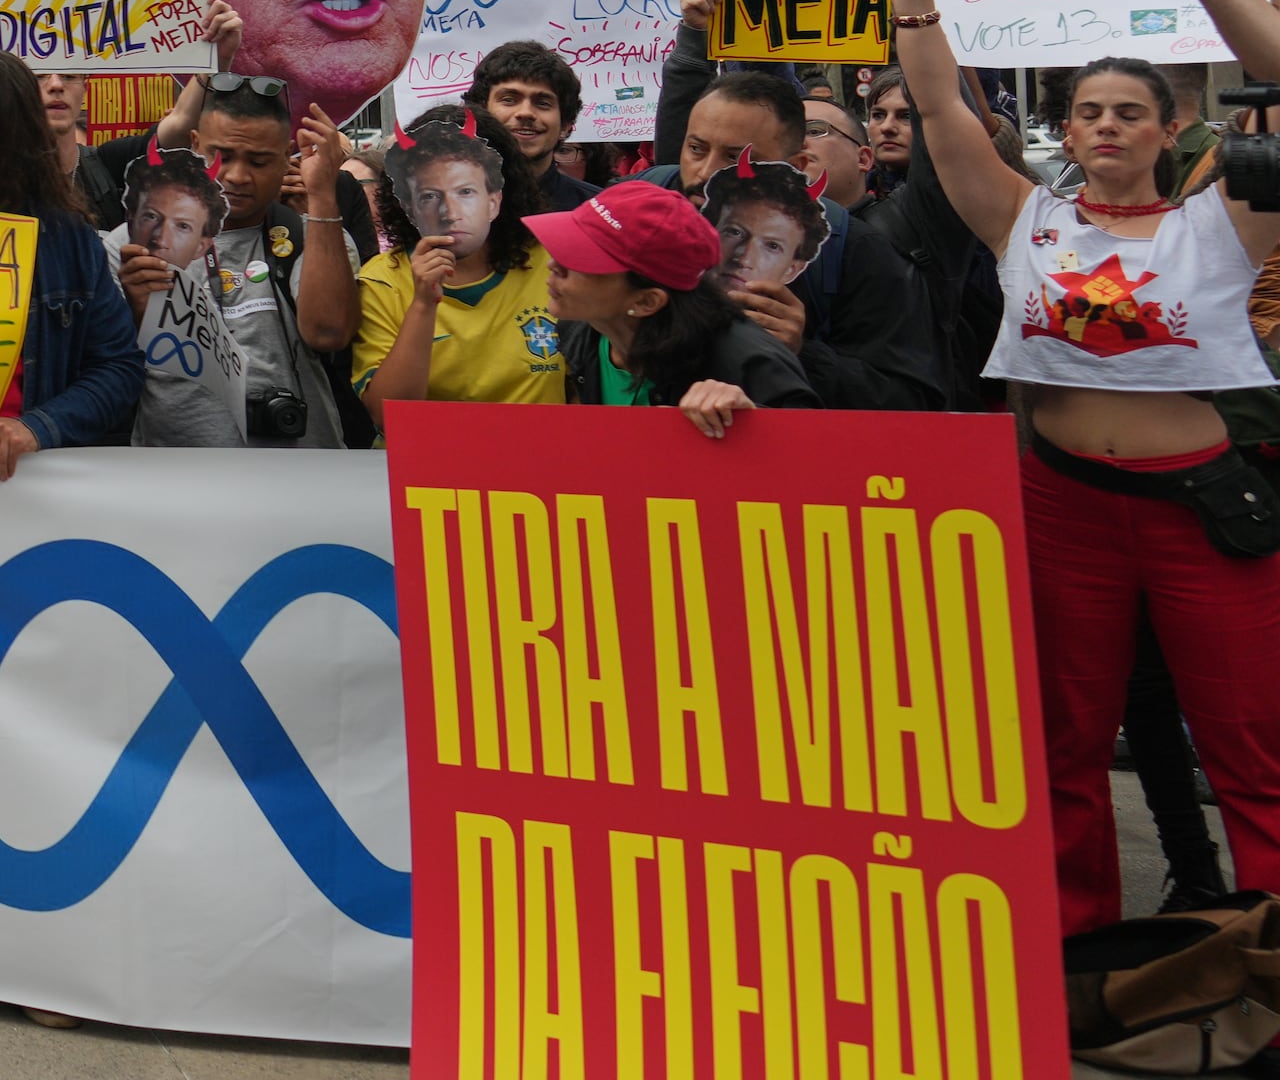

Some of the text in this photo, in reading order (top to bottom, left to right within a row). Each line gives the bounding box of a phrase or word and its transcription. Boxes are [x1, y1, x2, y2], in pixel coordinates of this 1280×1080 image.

[151, 20, 205, 53] META
[420, 8, 486, 34] META
[955, 17, 1039, 53] VOTE
[89, 78, 122, 125] TIRA
[125, 77, 136, 123] A
[158, 300, 232, 382] Meta
[406, 475, 1027, 829] TIRA A MÃO
[455, 811, 585, 1080] DA
